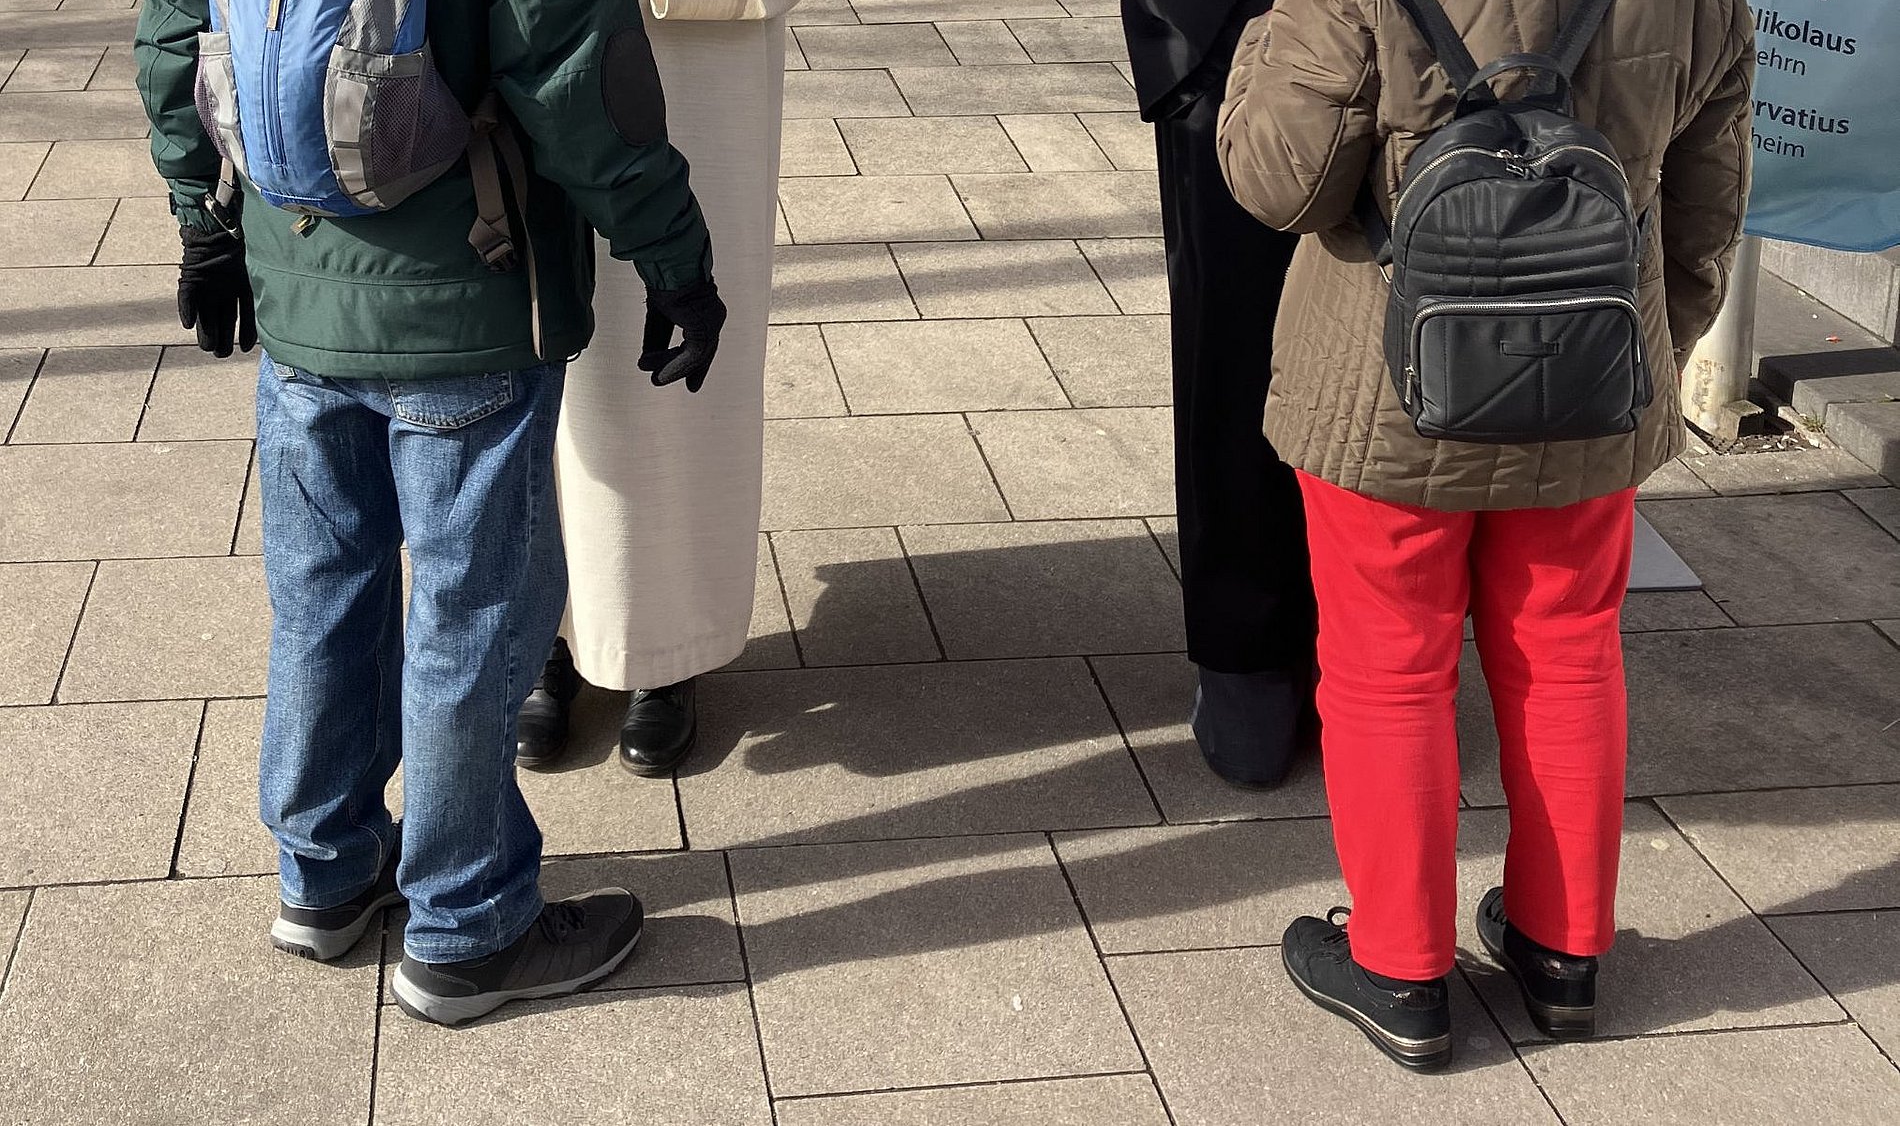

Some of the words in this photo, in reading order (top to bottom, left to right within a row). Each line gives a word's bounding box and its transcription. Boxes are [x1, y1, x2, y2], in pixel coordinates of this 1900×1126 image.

[1757, 47, 1806, 76] ehrn
[1752, 99, 1850, 134] rvatius
[1752, 127, 1805, 158] heim
